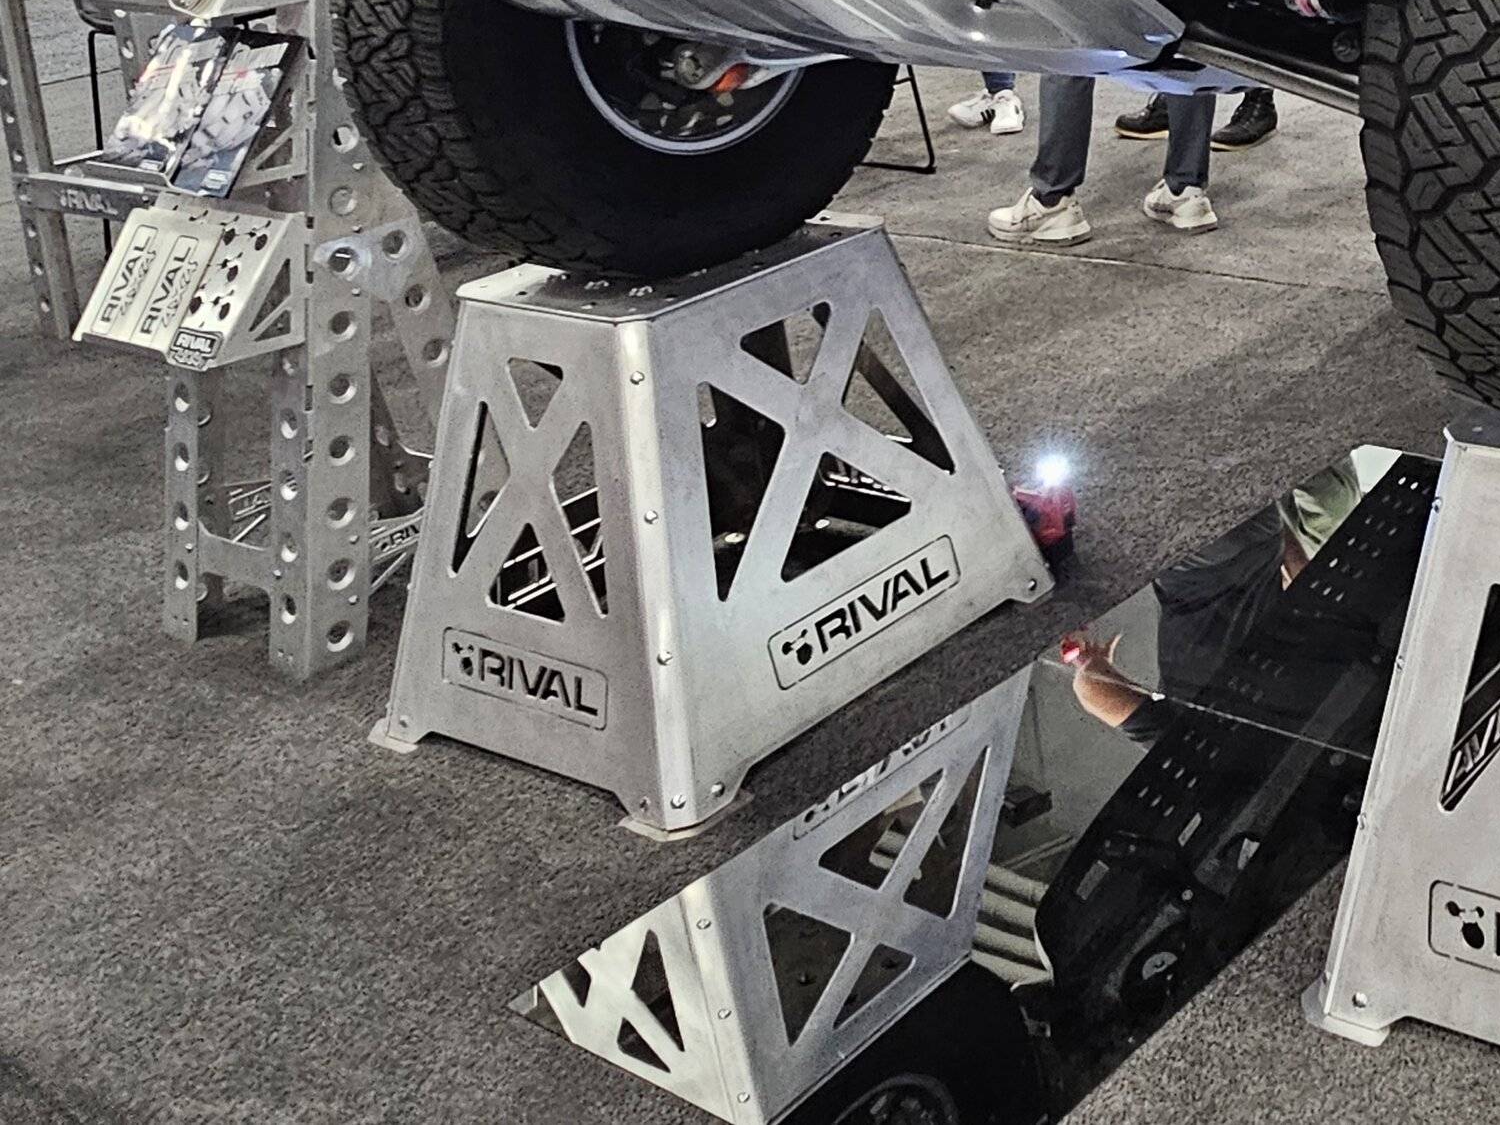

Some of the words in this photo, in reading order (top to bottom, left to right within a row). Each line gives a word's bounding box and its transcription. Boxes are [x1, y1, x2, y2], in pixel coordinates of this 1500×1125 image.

[100, 235, 152, 323] RIVAL
[139, 246, 192, 335] RIVAL
[815, 557, 950, 654] RIVAL
[479, 647, 599, 717] RIVAL
